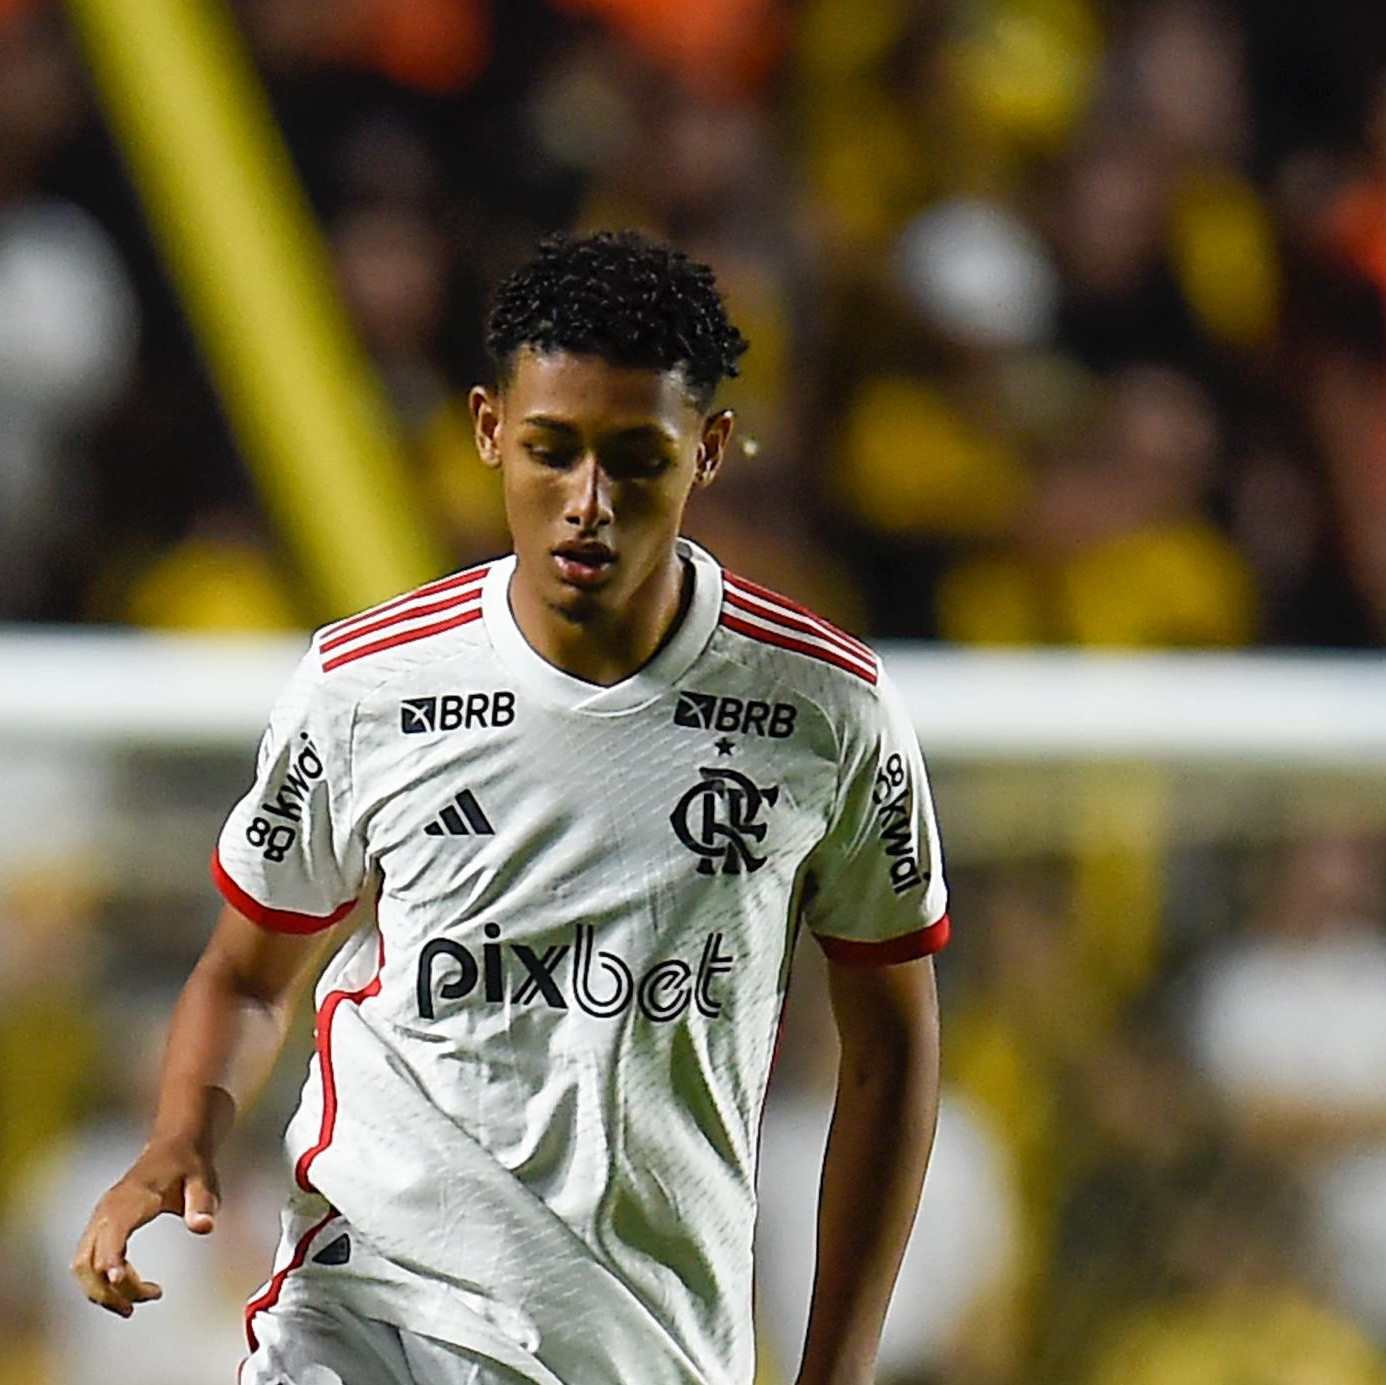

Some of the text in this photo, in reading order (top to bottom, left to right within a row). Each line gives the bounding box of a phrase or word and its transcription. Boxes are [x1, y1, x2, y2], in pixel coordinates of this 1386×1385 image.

[439, 691, 517, 731] BRB
[714, 697, 798, 739] BRB
[262, 731, 324, 823] kwai
[877, 788, 931, 894] kwai
[416, 922, 733, 1023] pixbet
